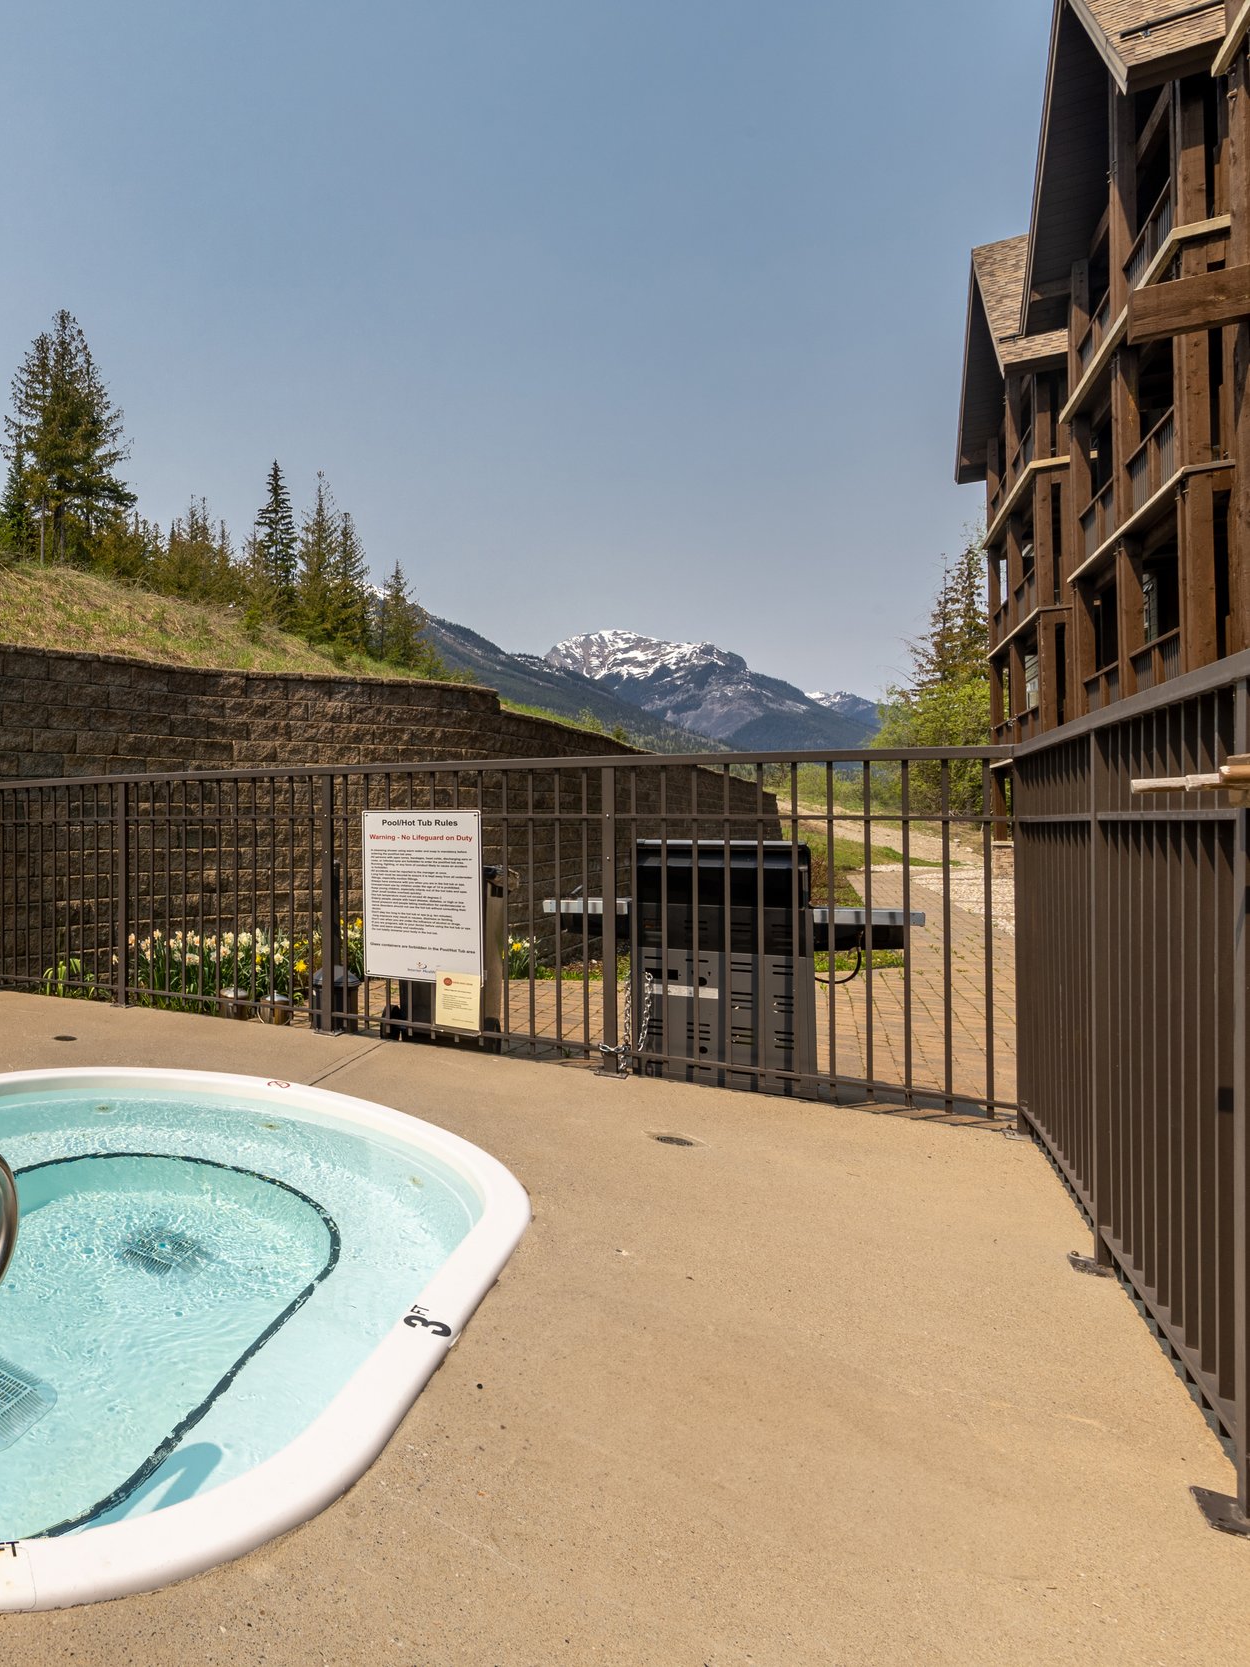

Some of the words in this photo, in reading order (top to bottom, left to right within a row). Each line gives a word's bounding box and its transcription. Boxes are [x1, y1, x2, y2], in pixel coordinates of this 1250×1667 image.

[381, 819, 415, 827] Pool/Hot
[417, 819, 432, 827] Tub
[434, 819, 458, 827] Rules
[412, 834, 444, 842] Lifeguard
[456, 834, 473, 842] Duty
[410, 1304, 430, 1316] FT
[403, 1315, 451, 1337] 3
